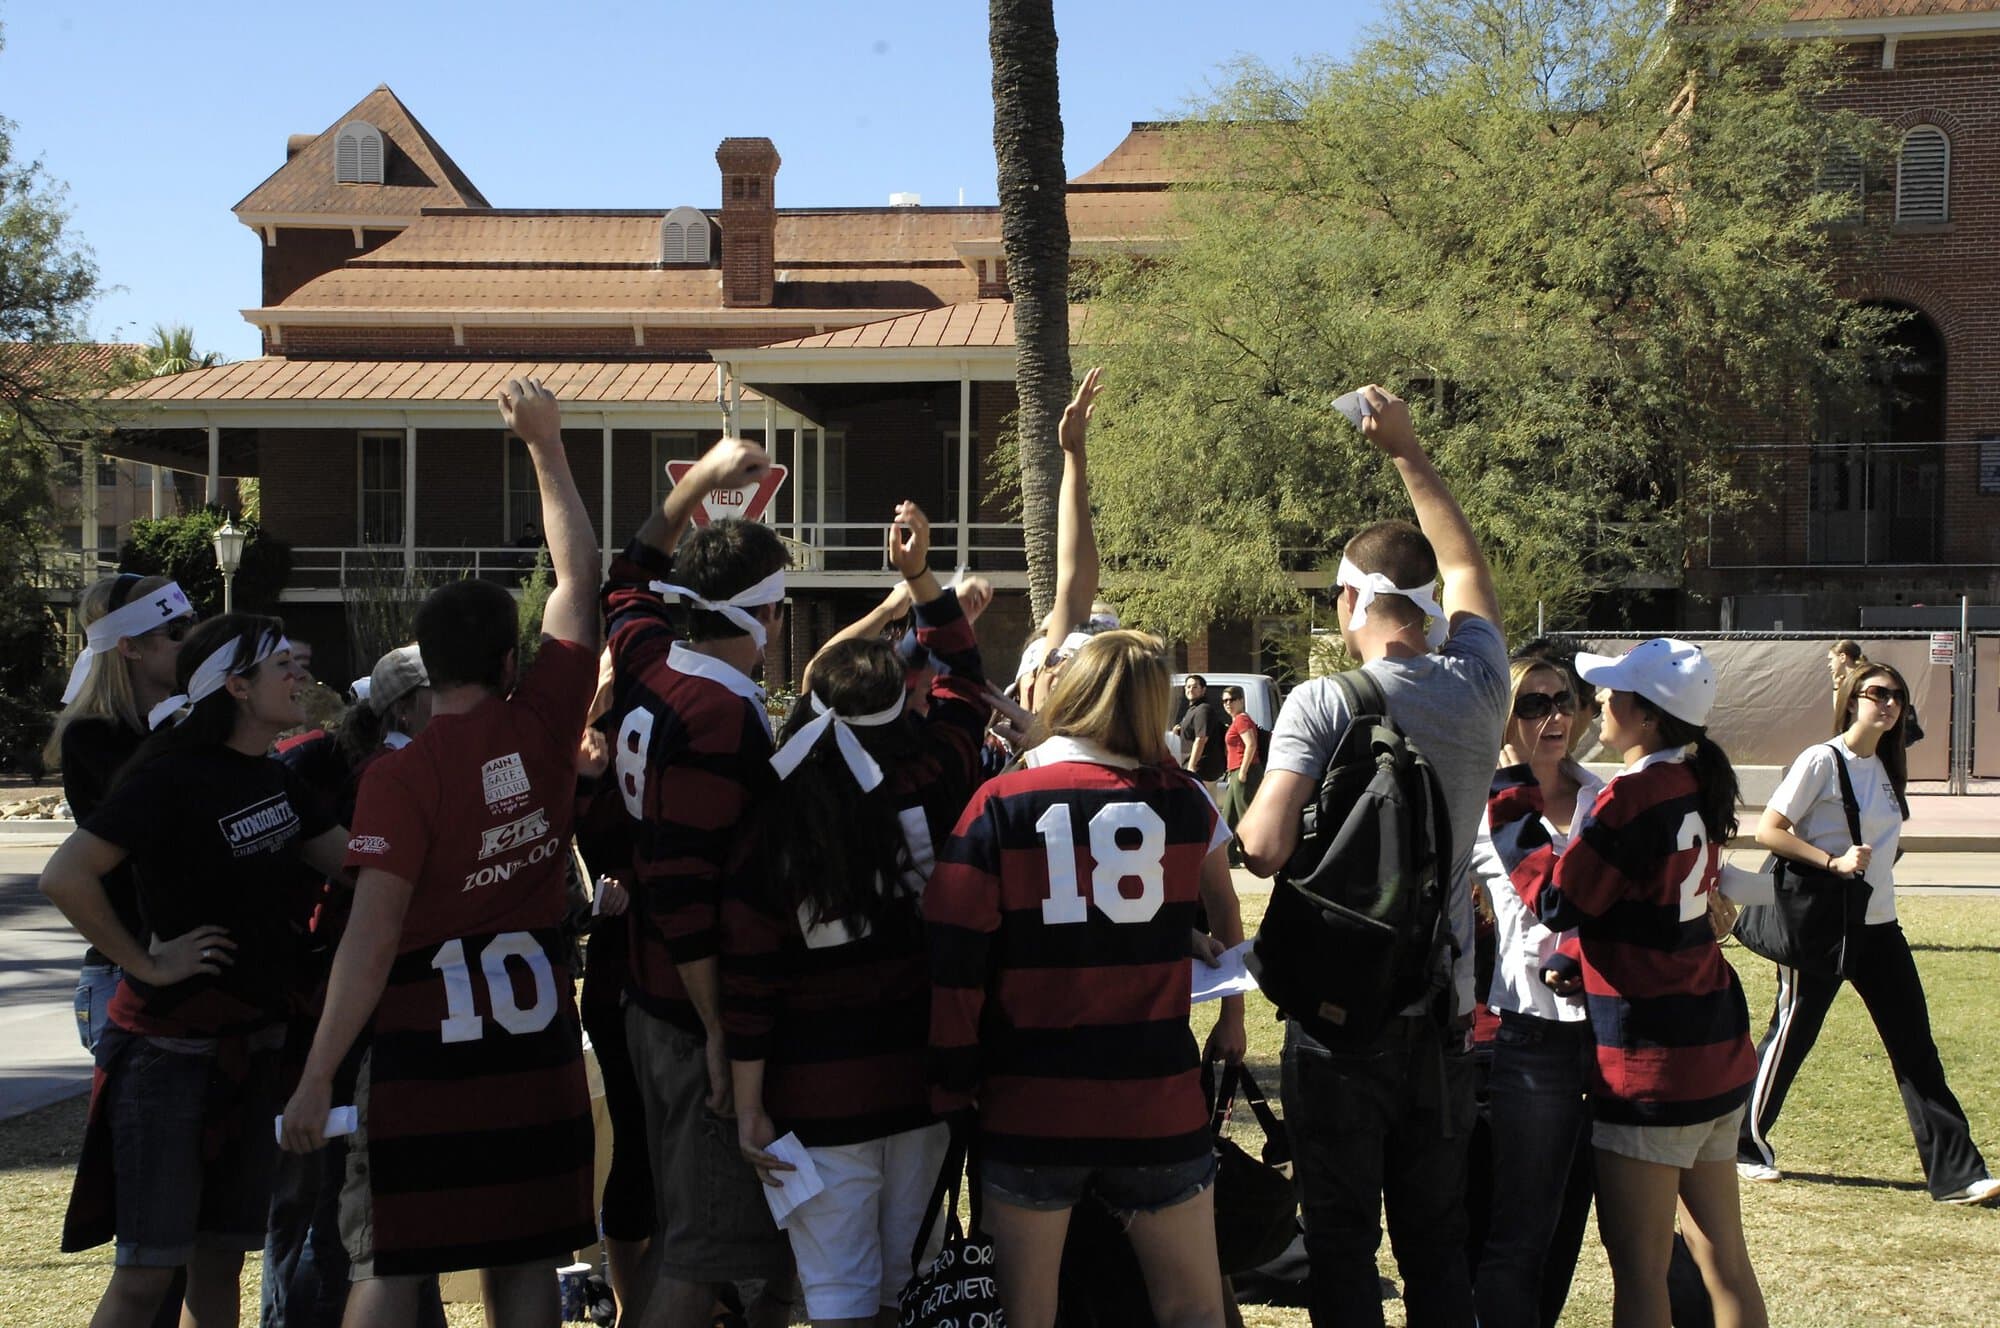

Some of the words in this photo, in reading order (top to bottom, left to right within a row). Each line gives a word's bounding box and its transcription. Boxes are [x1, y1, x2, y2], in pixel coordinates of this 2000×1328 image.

[709, 489, 744, 506] YIELD
[155, 598, 173, 617] I
[487, 769, 518, 786] GATE
[1035, 802, 1166, 925] 18
[1676, 811, 1709, 923] 2
[431, 931, 559, 1044] 10
